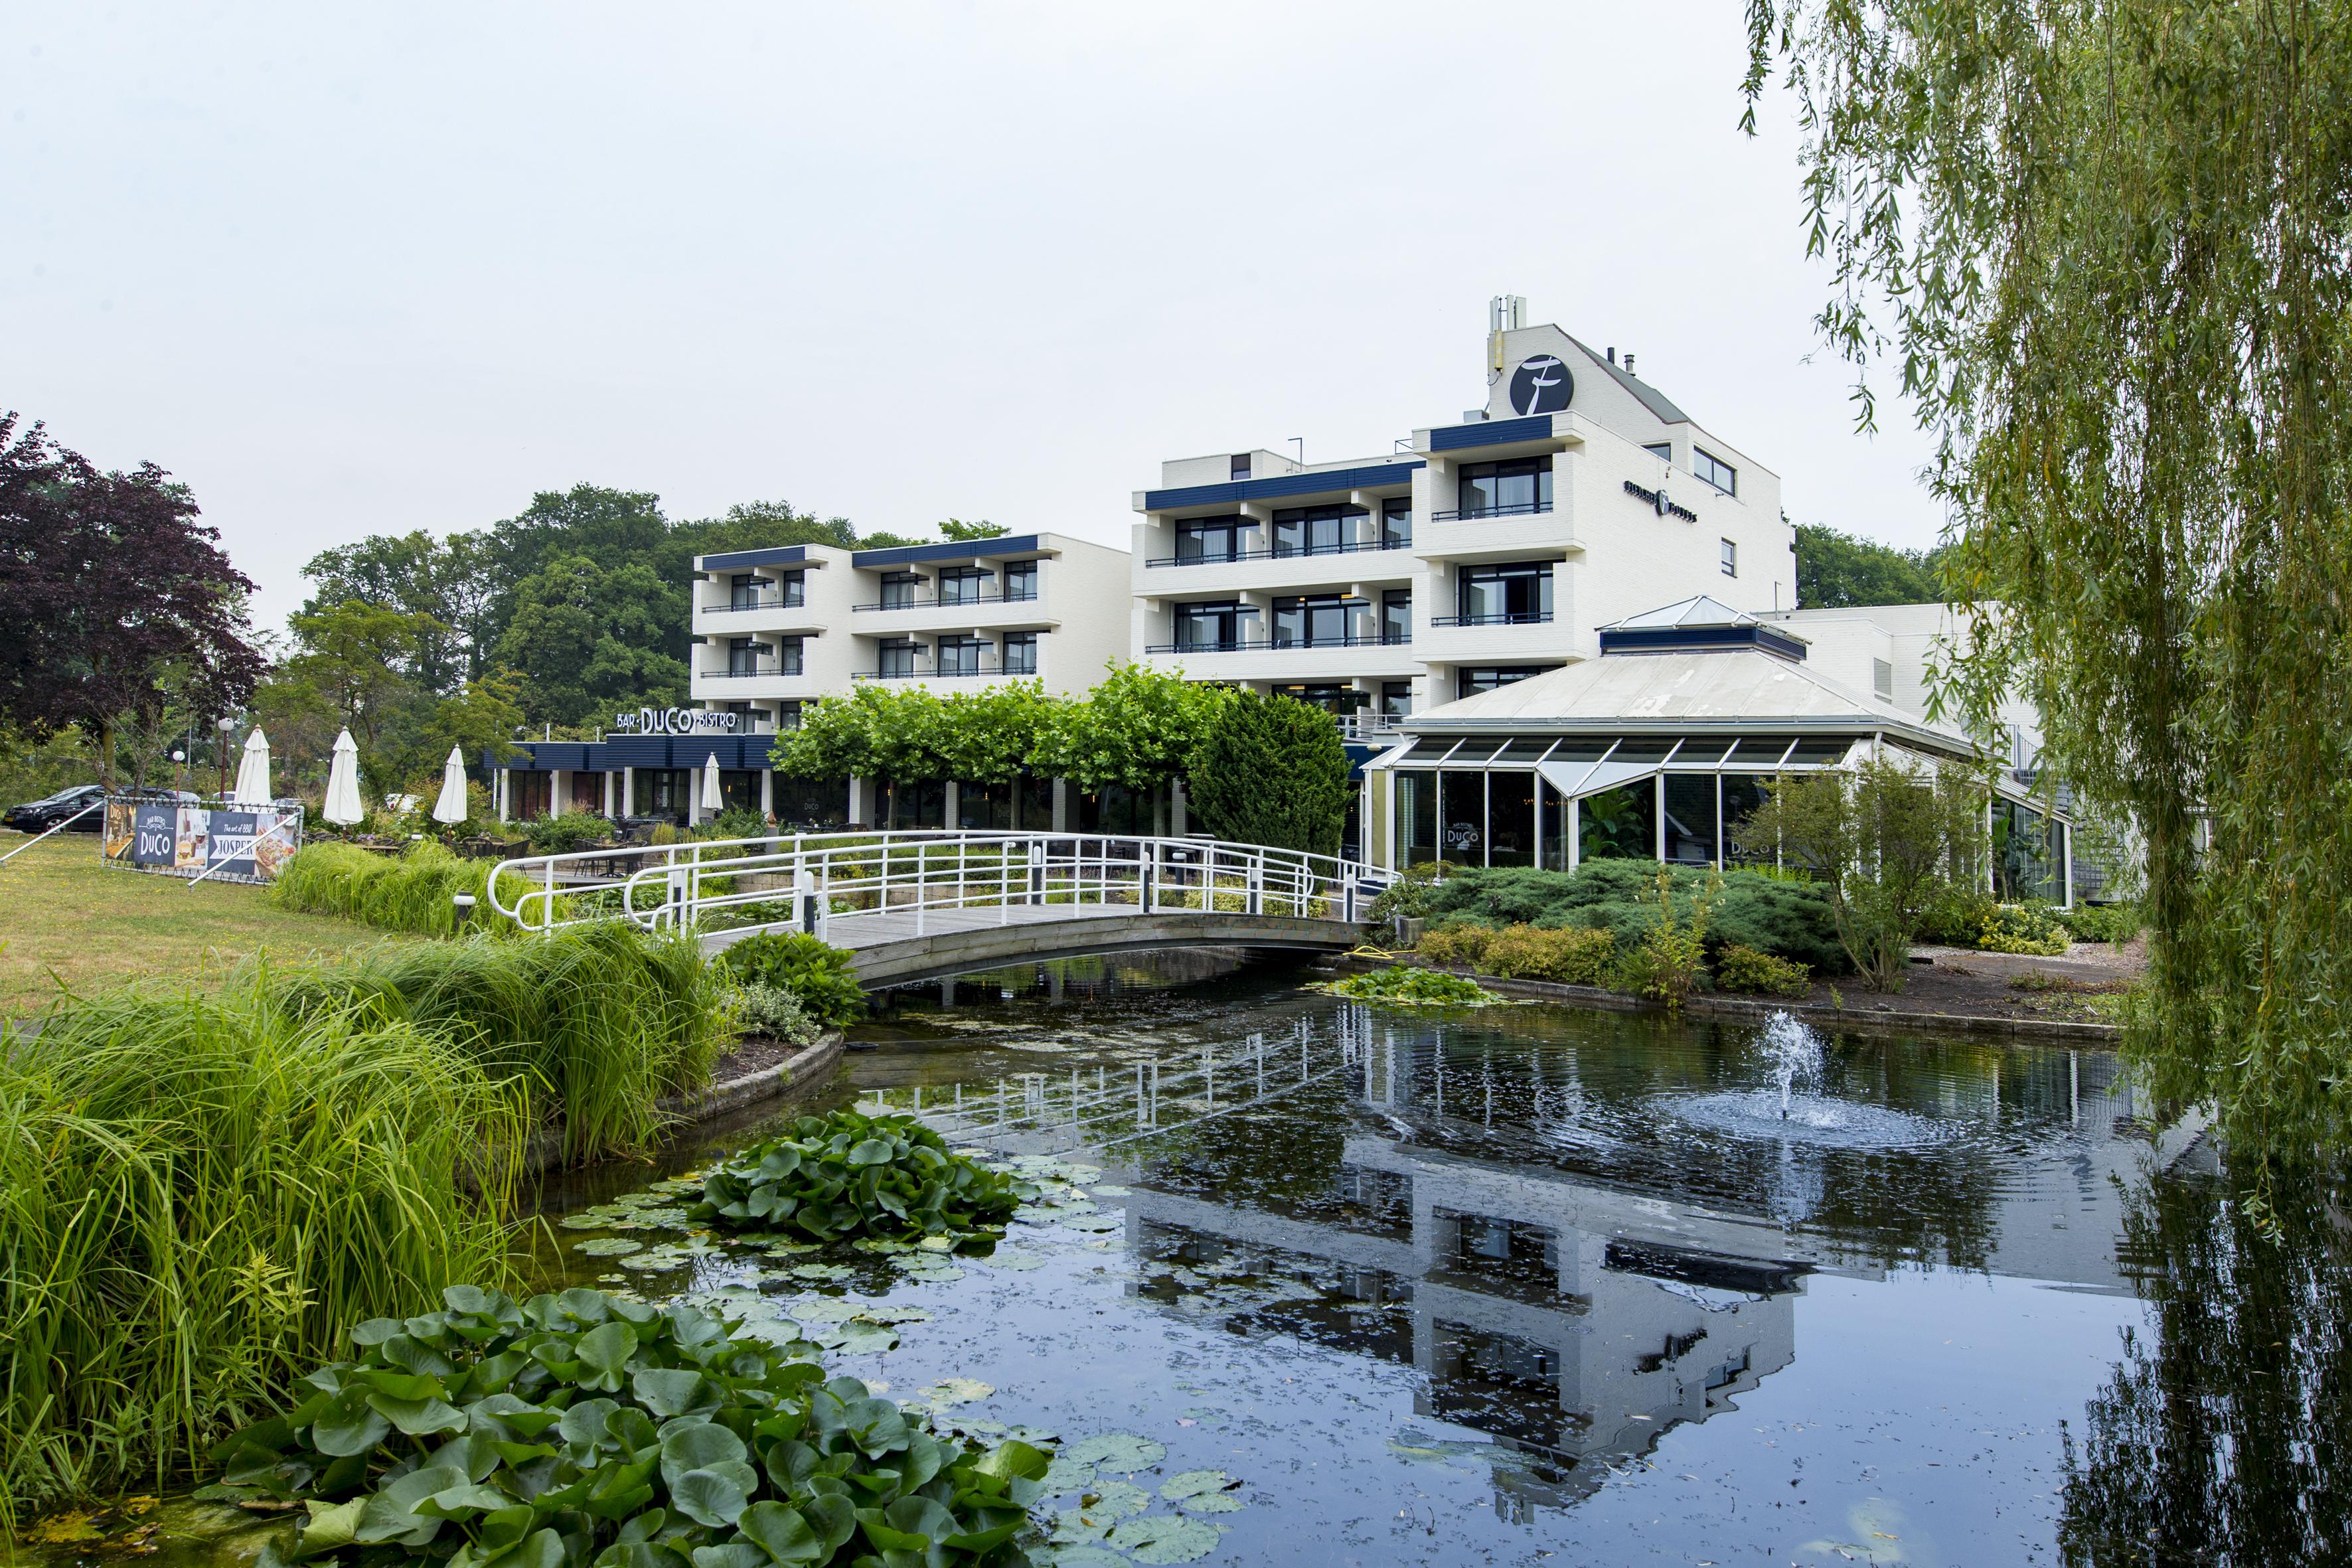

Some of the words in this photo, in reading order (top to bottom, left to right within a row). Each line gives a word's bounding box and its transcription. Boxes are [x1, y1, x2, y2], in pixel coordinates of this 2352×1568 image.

[617, 714, 636, 728] BAR
[698, 712, 738, 728] BISTRO
[238, 824, 243, 833] of
